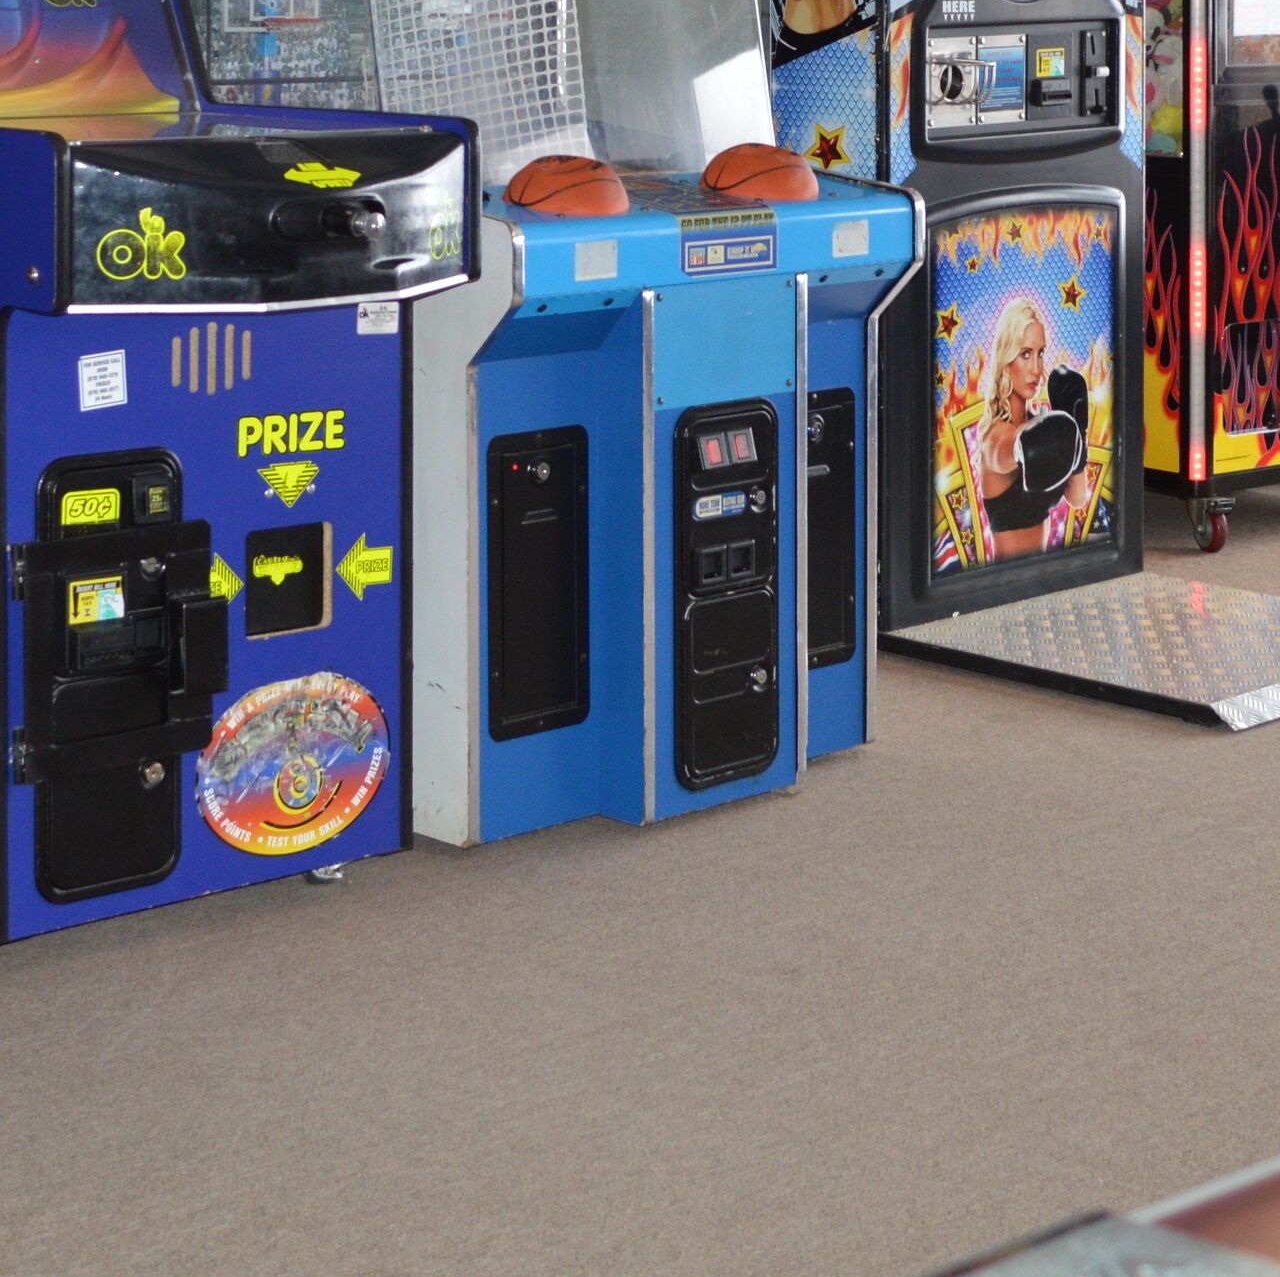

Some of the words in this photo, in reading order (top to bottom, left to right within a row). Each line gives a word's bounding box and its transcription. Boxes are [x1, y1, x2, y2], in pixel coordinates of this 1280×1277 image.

[942, 0, 976, 13] HERE
[694, 217, 711, 229] FOR
[712, 215, 729, 227] THE
[754, 211, 775, 223] PLAY
[238, 409, 346, 457] PRIZE
[68, 496, 113, 519] 50¢
[355, 558, 389, 574] PRIZE
[226, 708, 246, 730] WIN
[246, 704, 255, 714] A
[203, 787, 224, 822] SCORE
[220, 817, 252, 843] POINTS
[267, 835, 289, 847] TEST
[292, 830, 316, 846] YOUR
[319, 815, 344, 837] SKILL
[350, 785, 369, 807] WIN
[364, 746, 383, 785] PRIZES
